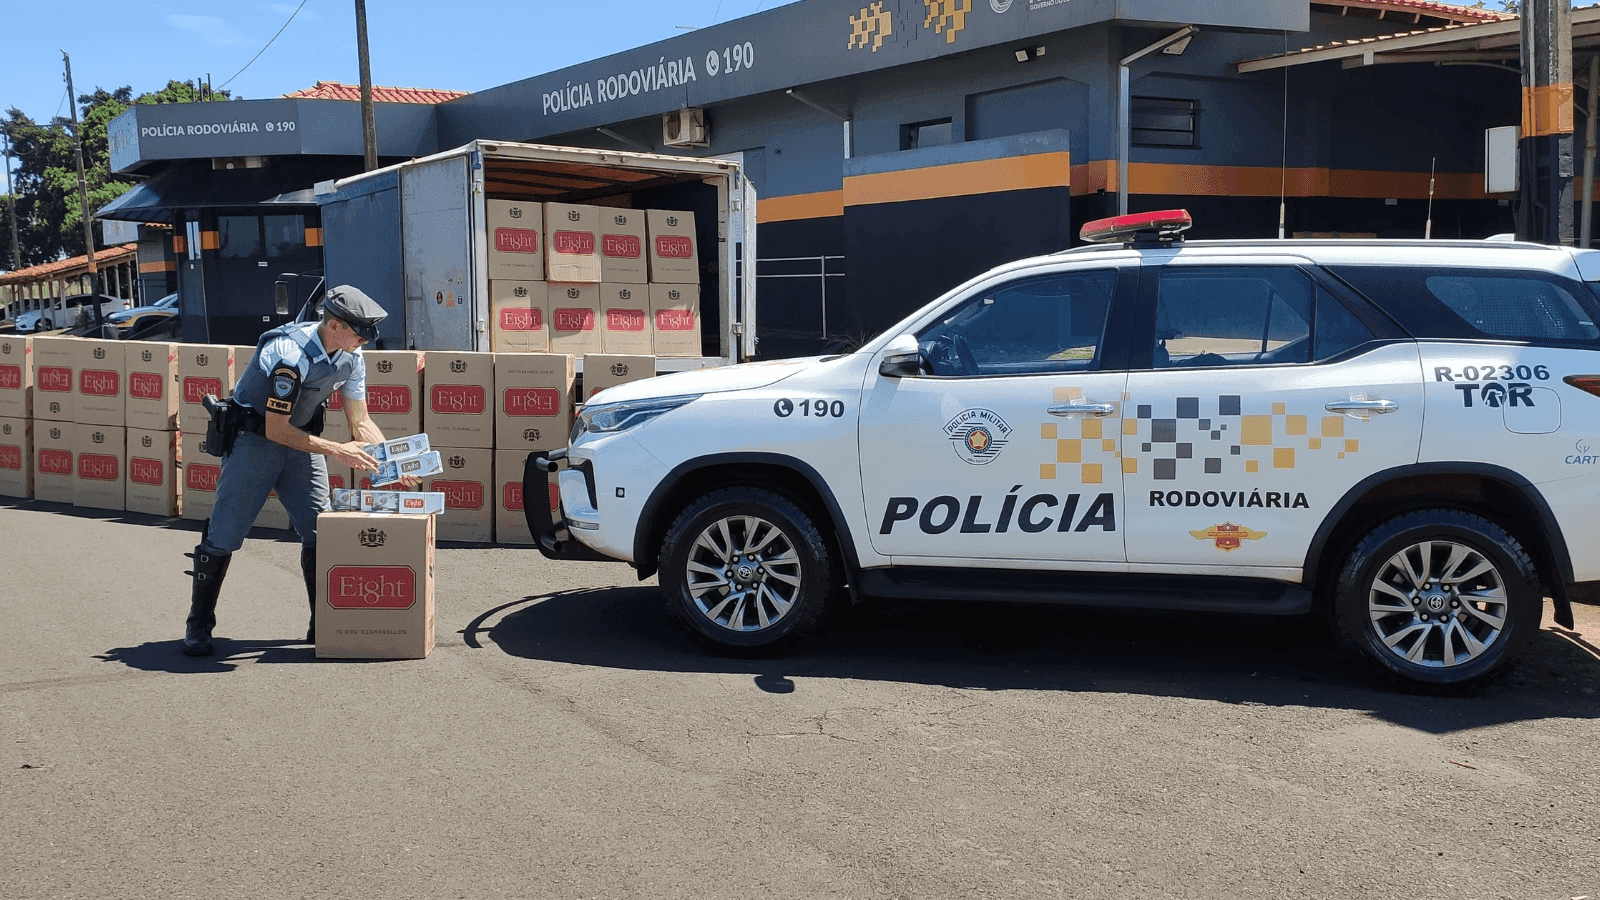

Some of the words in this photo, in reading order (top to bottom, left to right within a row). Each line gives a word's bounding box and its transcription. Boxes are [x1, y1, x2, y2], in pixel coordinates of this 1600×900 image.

[542, 81, 594, 116] POLÍCIA
[597, 56, 697, 103] RODOVIÁRIA
[723, 41, 754, 74] 190
[141, 124, 185, 138] POLÍCIA
[187, 120, 259, 136] RODOVIÁRIA
[276, 121, 296, 132] 190
[500, 233, 532, 250] Eight
[559, 236, 590, 253] Eight
[606, 239, 636, 255] Eight
[660, 240, 688, 255] Eight
[504, 312, 537, 330] Eight
[559, 313, 590, 329] Eight
[610, 313, 640, 330] Eight
[660, 313, 691, 329] Eight
[0, 370, 18, 387] ight
[1433, 364, 1551, 382] R-02306
[84, 374, 115, 393] Eight
[133, 377, 159, 396] Eight
[187, 382, 218, 401] Eight
[367, 390, 407, 411] Eight
[437, 390, 479, 411] Eight
[510, 390, 554, 411] Eight
[798, 399, 845, 418] 190
[979, 410, 1008, 434] MILITAR
[82, 459, 113, 477] Eight
[1564, 455, 1600, 465] CART
[133, 462, 159, 481] Eight
[190, 469, 218, 488] Eight
[1149, 487, 1310, 509] RODOVIÁRIA
[879, 484, 1117, 535] POLÍCIA
[337, 575, 406, 605] Eight
